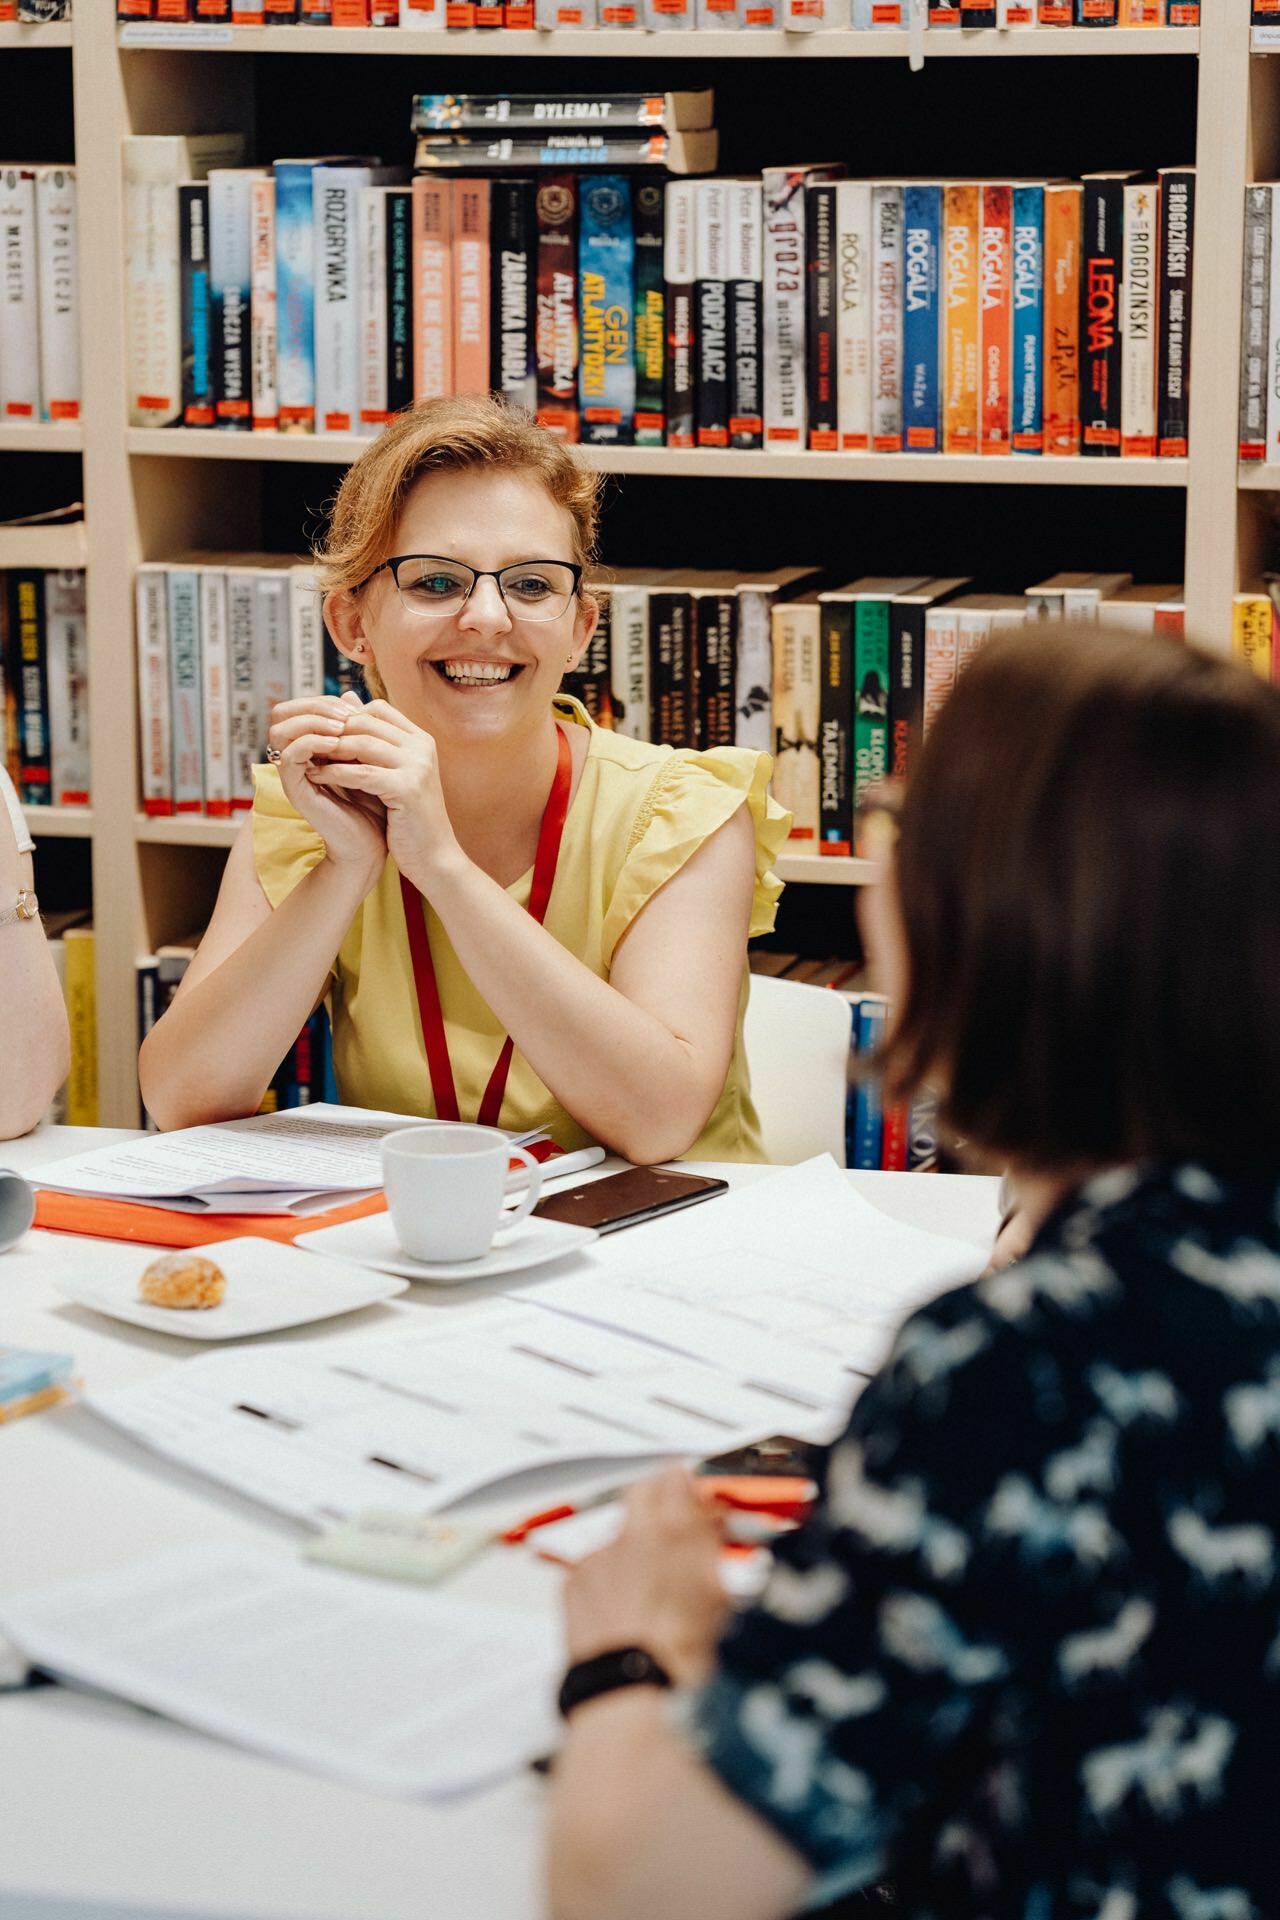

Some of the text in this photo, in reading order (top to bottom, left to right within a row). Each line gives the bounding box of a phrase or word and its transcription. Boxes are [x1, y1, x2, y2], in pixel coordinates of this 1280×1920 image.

[533, 103, 612, 119] DYLEMAT
[324, 188, 347, 303] ROZGRYWKA
[769, 222, 800, 292] groza
[881, 202, 897, 249] ROGALA
[1166, 193, 1190, 278] ROGOZIŃSKI
[53, 223, 71, 314] POLICJA
[501, 250, 526, 330] ZABAWKA
[736, 282, 754, 298] W
[842, 233, 859, 312] ROGALA
[878, 261, 898, 311] KIEDYŚ
[906, 228, 928, 311] ROGALA
[947, 226, 969, 309] ROGALA
[983, 226, 1004, 310] ROGALA
[1014, 226, 1036, 310] ROGALA
[1088, 258, 1114, 352] LEONA
[1129, 232, 1153, 341] ROGOZIŃSKI
[553, 271, 573, 391] ATLANTYDZKA
[583, 271, 604, 396] ATLANTYDZKI
[605, 304, 629, 365] GEN
[646, 290, 664, 379] ATLANTYDZKI
[701, 282, 726, 383] PODPALACZ
[736, 301, 756, 354] MOGILE
[223, 348, 241, 399] WYSPA
[300, 604, 316, 690] LISELOTTE
[628, 622, 645, 705] ROLLINS
[822, 719, 838, 811] TAJEMNICE
